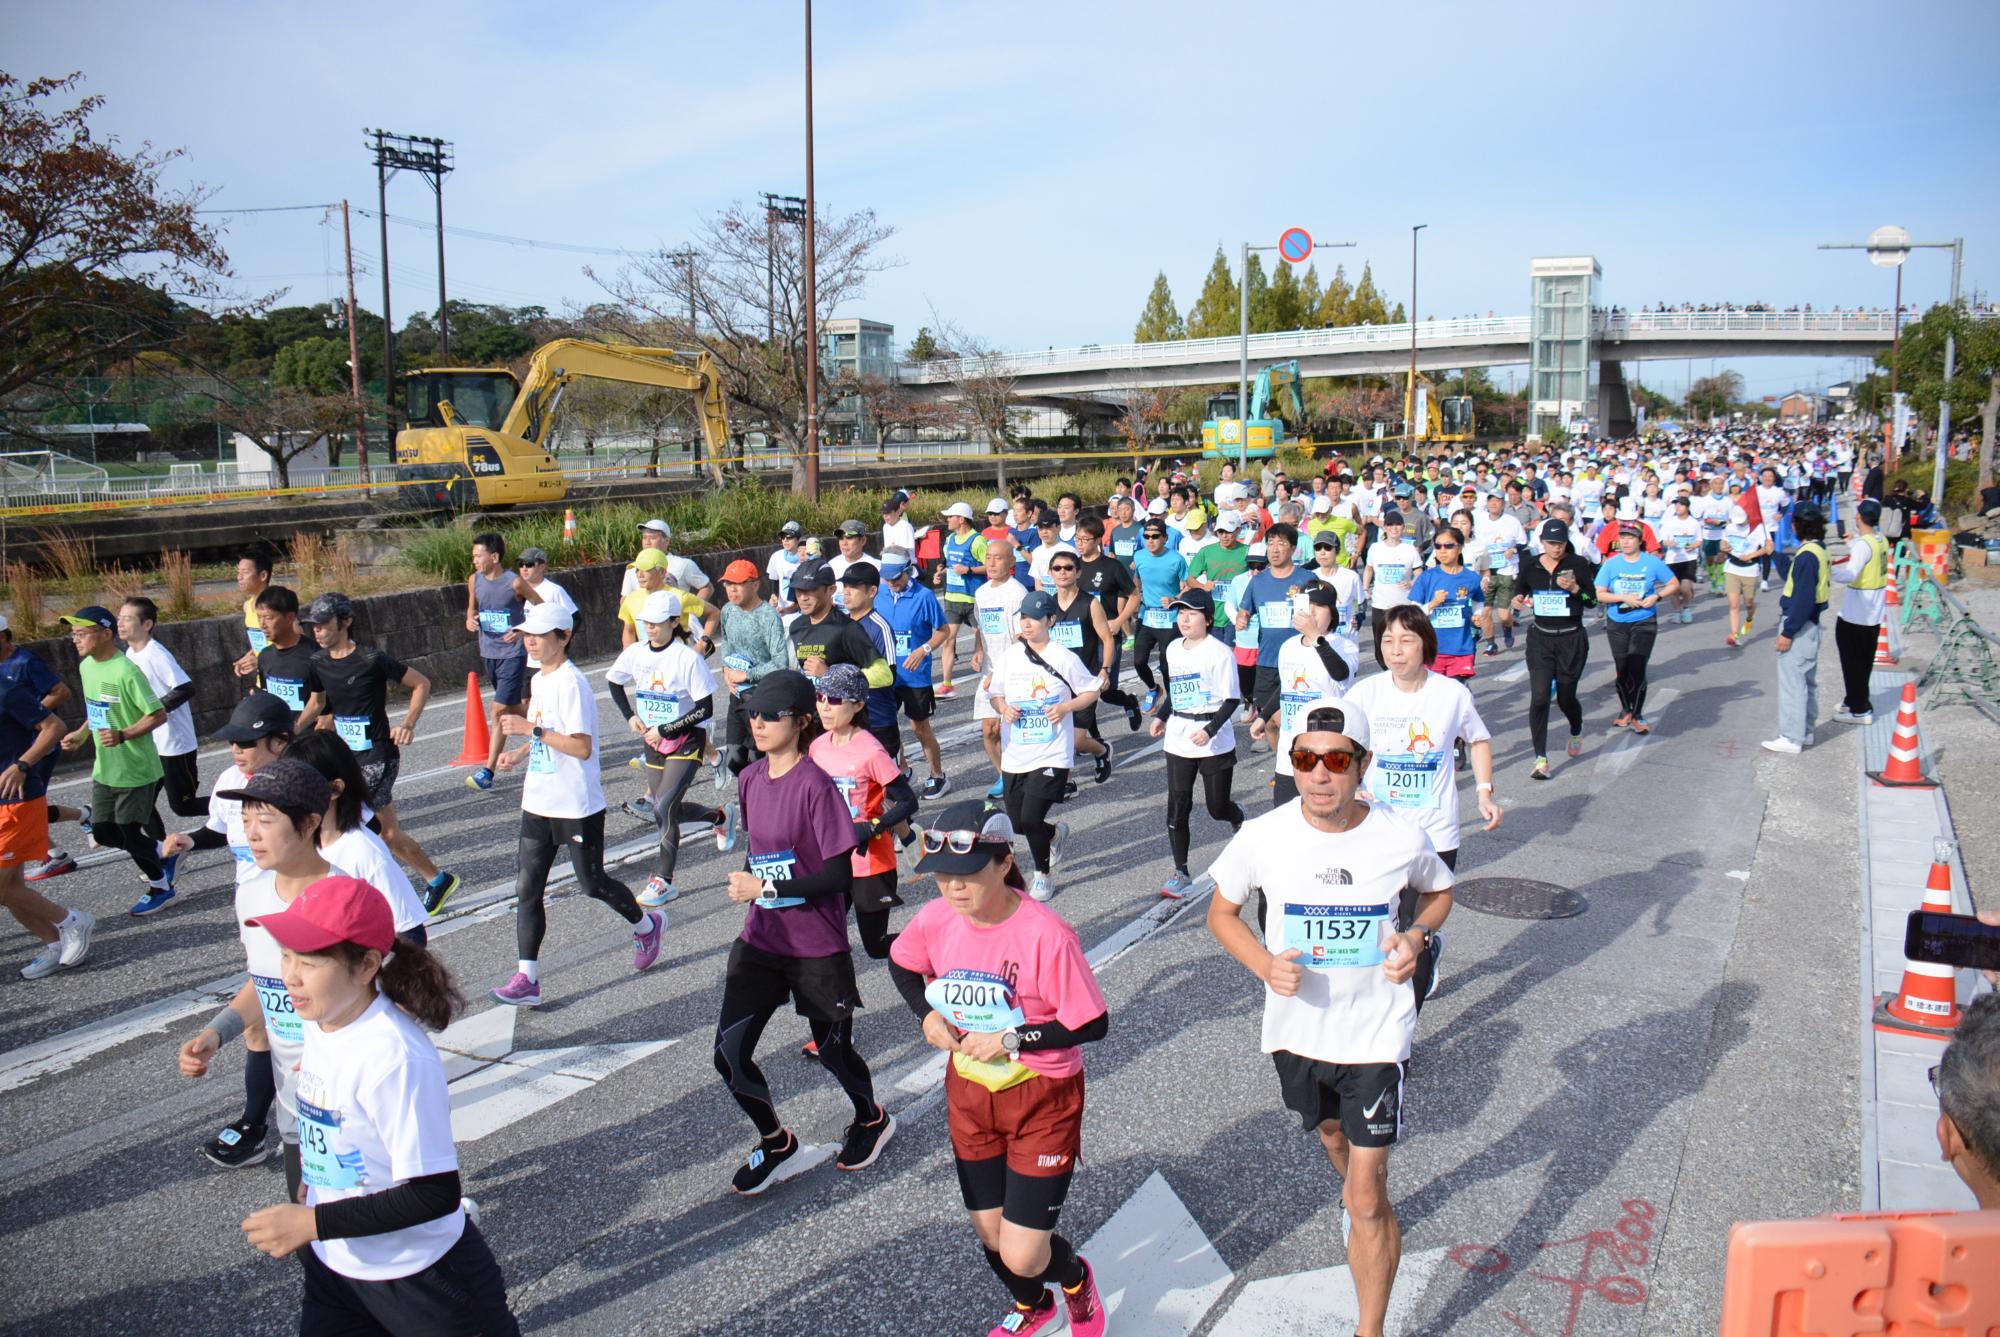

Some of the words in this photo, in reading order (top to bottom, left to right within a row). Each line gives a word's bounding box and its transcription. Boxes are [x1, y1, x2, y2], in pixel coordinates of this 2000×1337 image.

[1538, 597, 1563, 605] 12060
[484, 615, 505, 623] 11536
[980, 613, 1000, 622] 11906
[1434, 608, 1459, 617] 12002
[1172, 682, 1195, 695] 2330
[644, 700, 673, 714] 12238
[1385, 772, 1426, 788] 12011
[1303, 919, 1371, 940] 11537
[942, 983, 998, 1007] 12001
